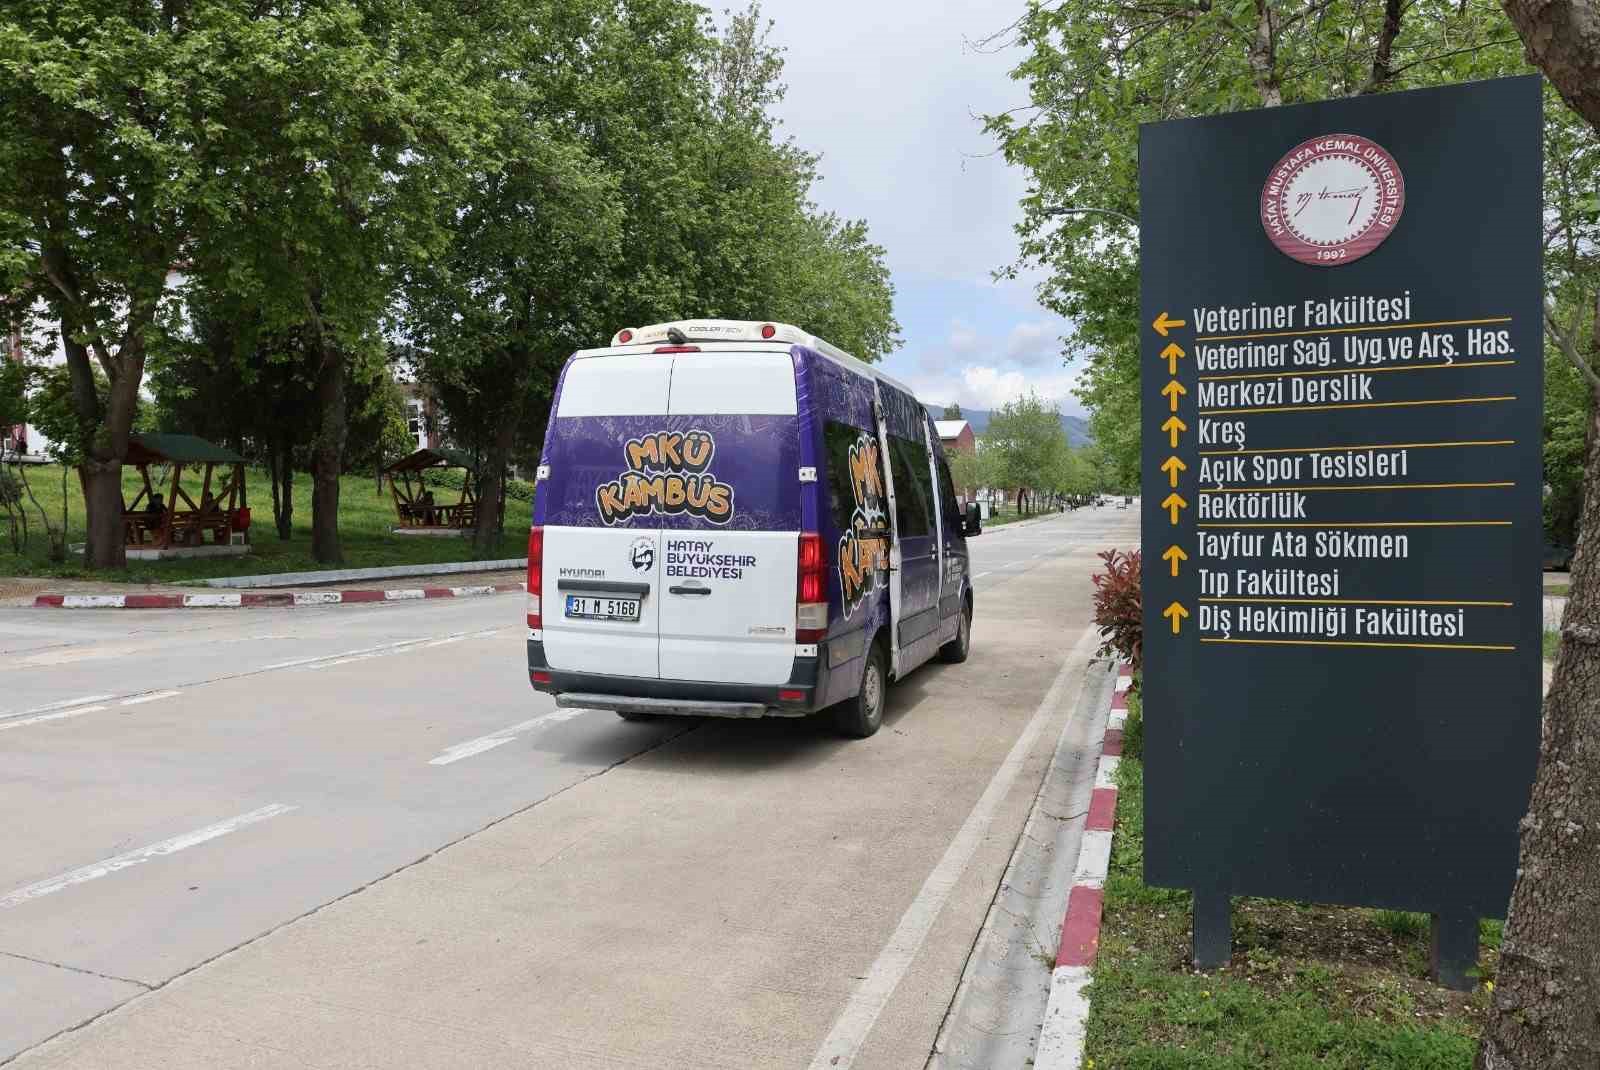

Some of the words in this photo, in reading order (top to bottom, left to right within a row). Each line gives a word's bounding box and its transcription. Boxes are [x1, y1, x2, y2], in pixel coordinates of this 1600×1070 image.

[1315, 140, 1361, 154] KEMAL
[1269, 148, 1315, 195] MUSTAFA
[1264, 199, 1285, 236] HATAY
[1316, 249, 1347, 260] 1992
[1193, 302, 1298, 335] Veteriner
[1304, 290, 1410, 323] Fakültesi
[1194, 341, 1289, 371] Veteriner
[1293, 336, 1337, 367] Sağ.
[1418, 331, 1461, 367] Arş.
[1467, 328, 1515, 356] Has.
[1198, 376, 1283, 408] Merkezi
[1291, 373, 1373, 404] Derslik
[1198, 418, 1246, 452] Kreş
[625, 431, 715, 472] MKÜ
[1199, 456, 1247, 491] Açık
[1252, 455, 1304, 484] Spor
[1309, 449, 1407, 479] Tesisleri
[1198, 491, 1306, 519] Rektörlük
[667, 540, 714, 552] HATAY
[667, 552, 756, 567] BÜYÜKŞEHİR
[1196, 531, 1265, 561] Tayfur
[1271, 531, 1307, 558] Ata
[1315, 530, 1408, 559] Sökmen
[559, 567, 606, 577] HYUNDAI
[666, 565, 743, 580] BELEDİYESİ
[1198, 568, 1229, 598] Tıp
[1237, 568, 1339, 596] Fakültesi
[573, 599, 586, 613] 31
[607, 601, 635, 616] 5168
[1199, 605, 1232, 640] Diş
[1238, 606, 1347, 637] Hekimliği
[1355, 607, 1464, 637] Fakültesi
